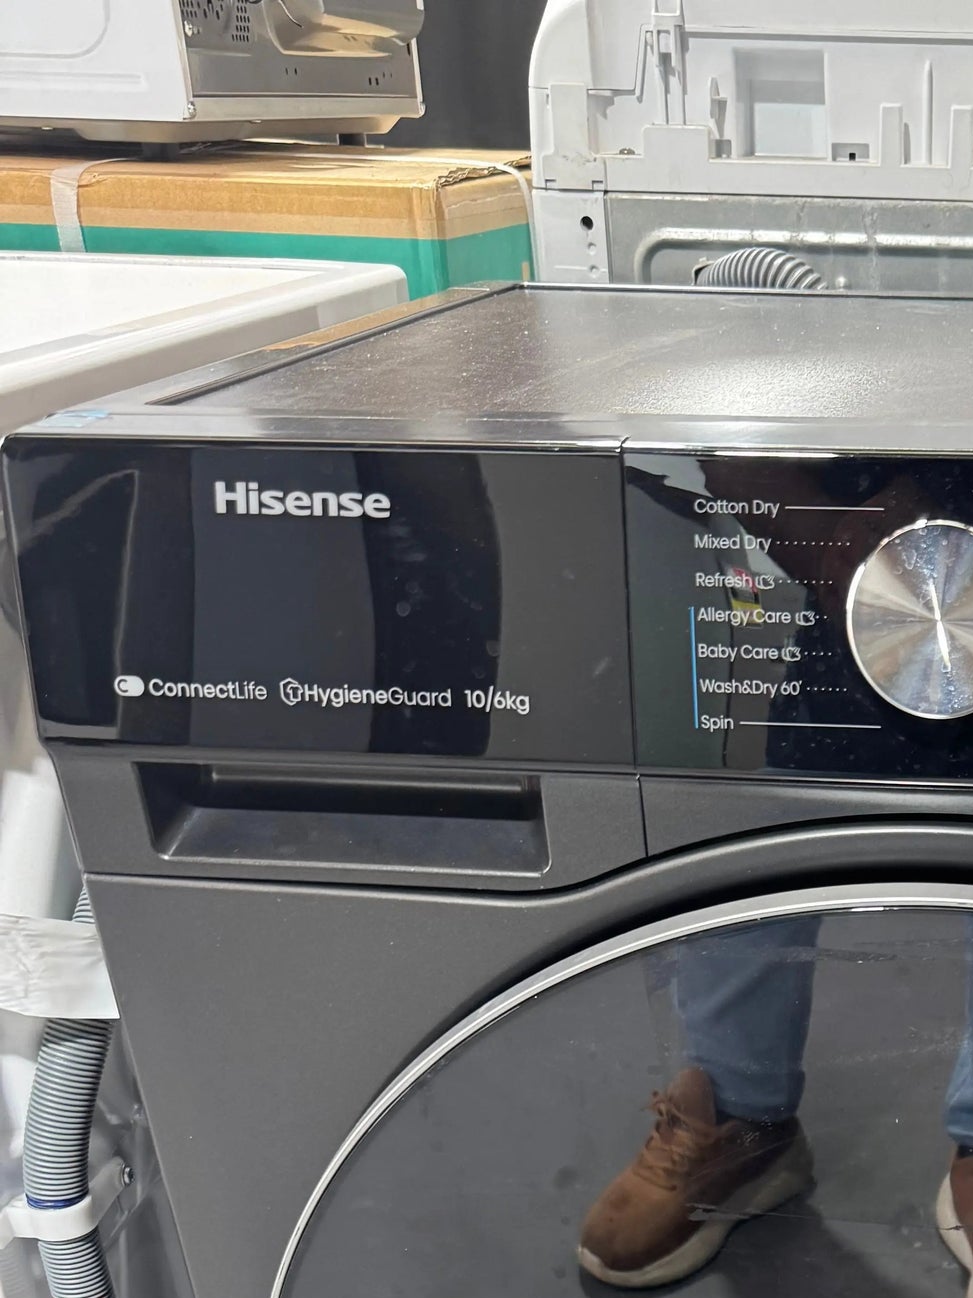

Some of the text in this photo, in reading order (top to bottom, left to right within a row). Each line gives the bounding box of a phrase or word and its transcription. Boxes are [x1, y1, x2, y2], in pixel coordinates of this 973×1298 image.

[214, 481, 391, 519] Hisense
[694, 499, 780, 518] Cotton Dry
[694, 534, 771, 554] Mixed Dry
[696, 573, 752, 587] Refresh
[697, 607, 791, 625] Allergy Care
[698, 644, 778, 661] Baby Care
[148, 678, 530, 715] ConnectLife HygieneGuard 10/6kg
[700, 679, 778, 698] Wash&Dry
[701, 715, 734, 732] Spin
